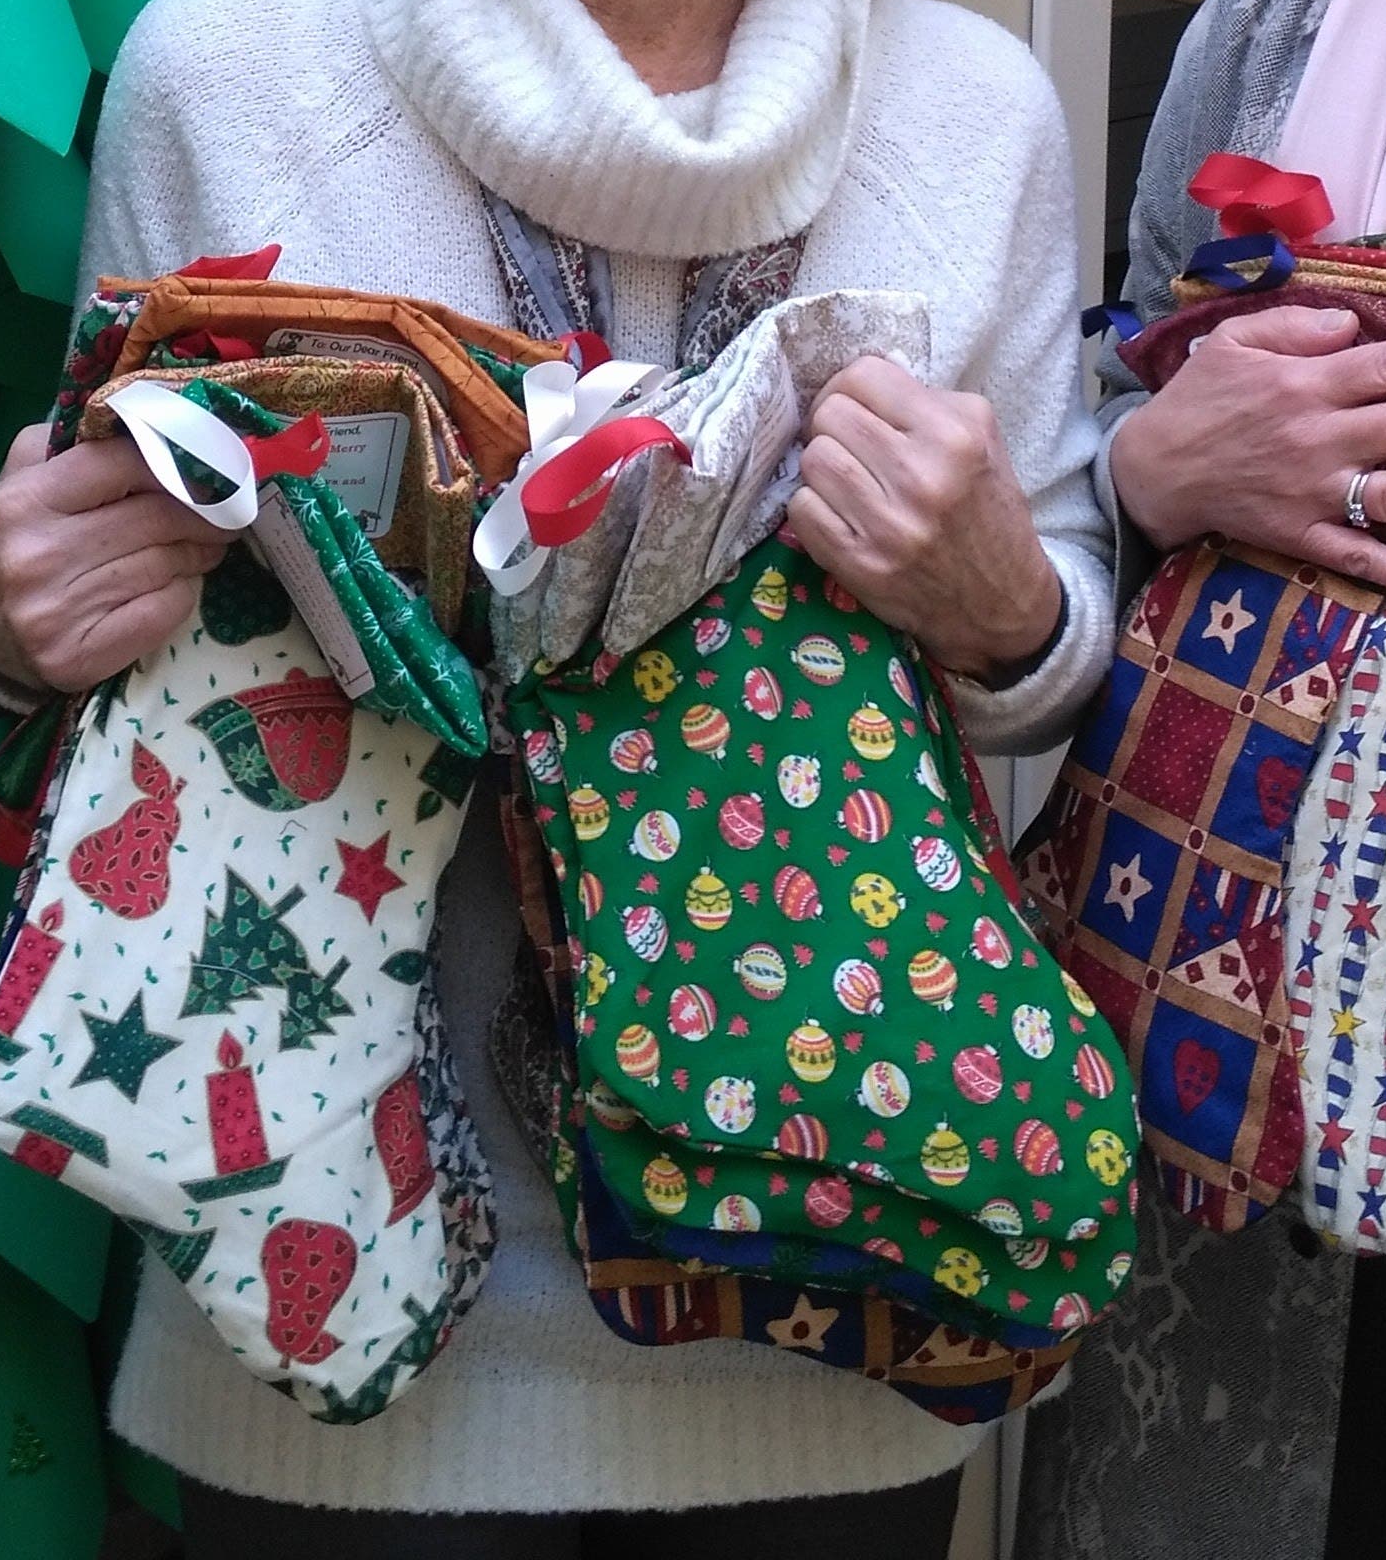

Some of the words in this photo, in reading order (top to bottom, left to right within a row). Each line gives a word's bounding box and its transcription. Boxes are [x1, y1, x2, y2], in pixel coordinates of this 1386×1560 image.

[329, 341, 351, 352] Our
[352, 342, 380, 355] Dear
[330, 443, 367, 454] Merry
